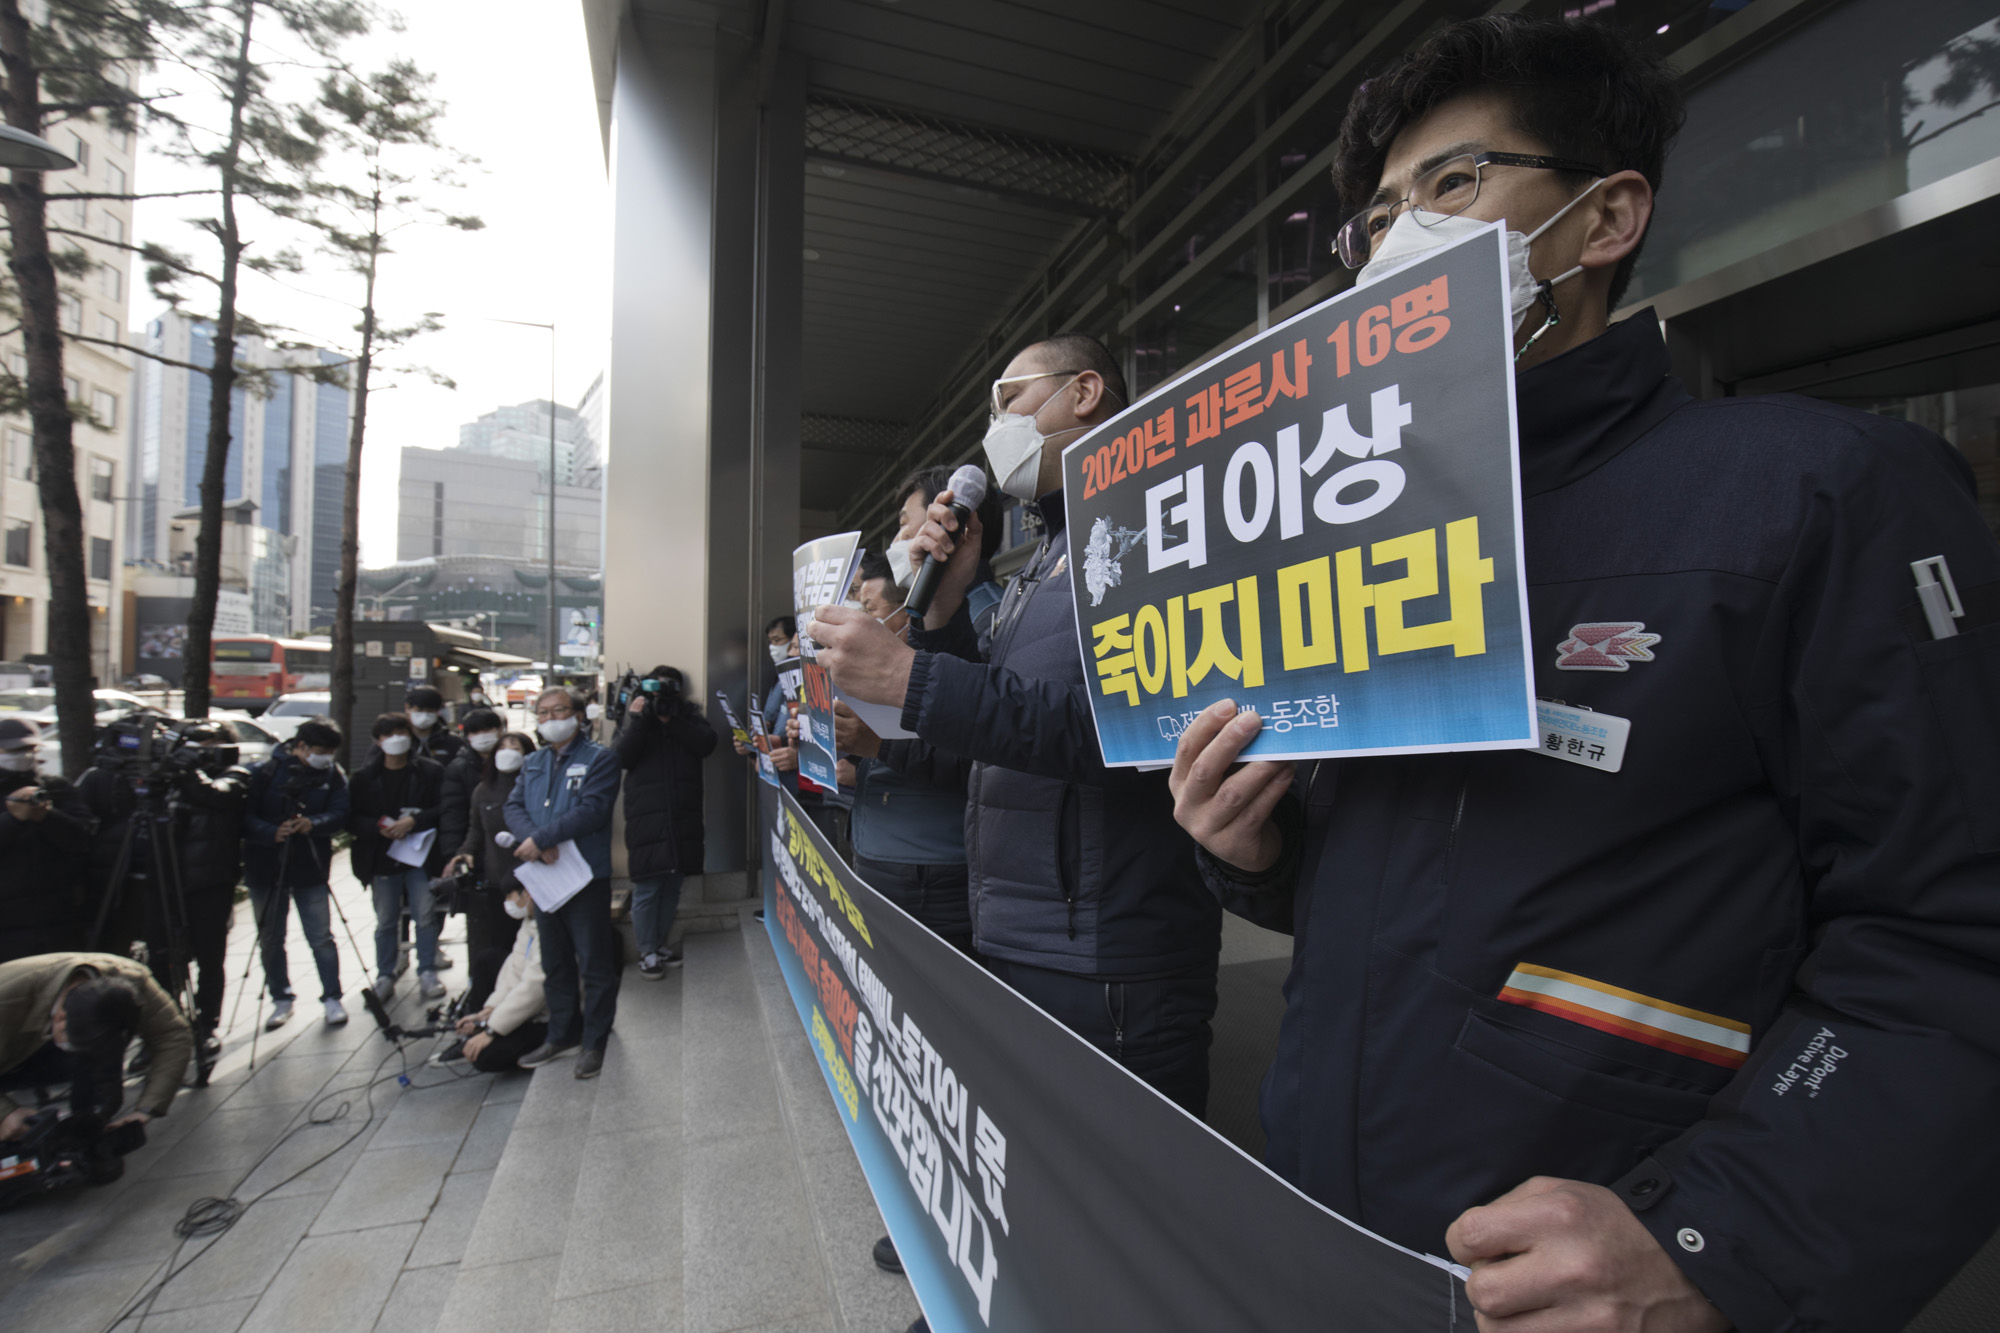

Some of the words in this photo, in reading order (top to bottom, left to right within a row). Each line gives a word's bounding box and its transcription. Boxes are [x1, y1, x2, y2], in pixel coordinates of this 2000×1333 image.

[1082, 412, 1176, 500] 2020년
[1185, 337, 1312, 449] 과로사
[1326, 274, 1451, 378] 16명
[1144, 463, 1207, 574] 더
[1222, 383, 1412, 543] 이상
[1092, 575, 1265, 707] 죽이지
[1276, 515, 1495, 674] 마라
[1180, 693, 1340, 734] 전동조합
[1772, 1063, 1809, 1096] Layer
[1797, 1027, 1835, 1063] Active
[872, 1040, 998, 1328] 선포합니다
[974, 1104, 1010, 1237] 몫
